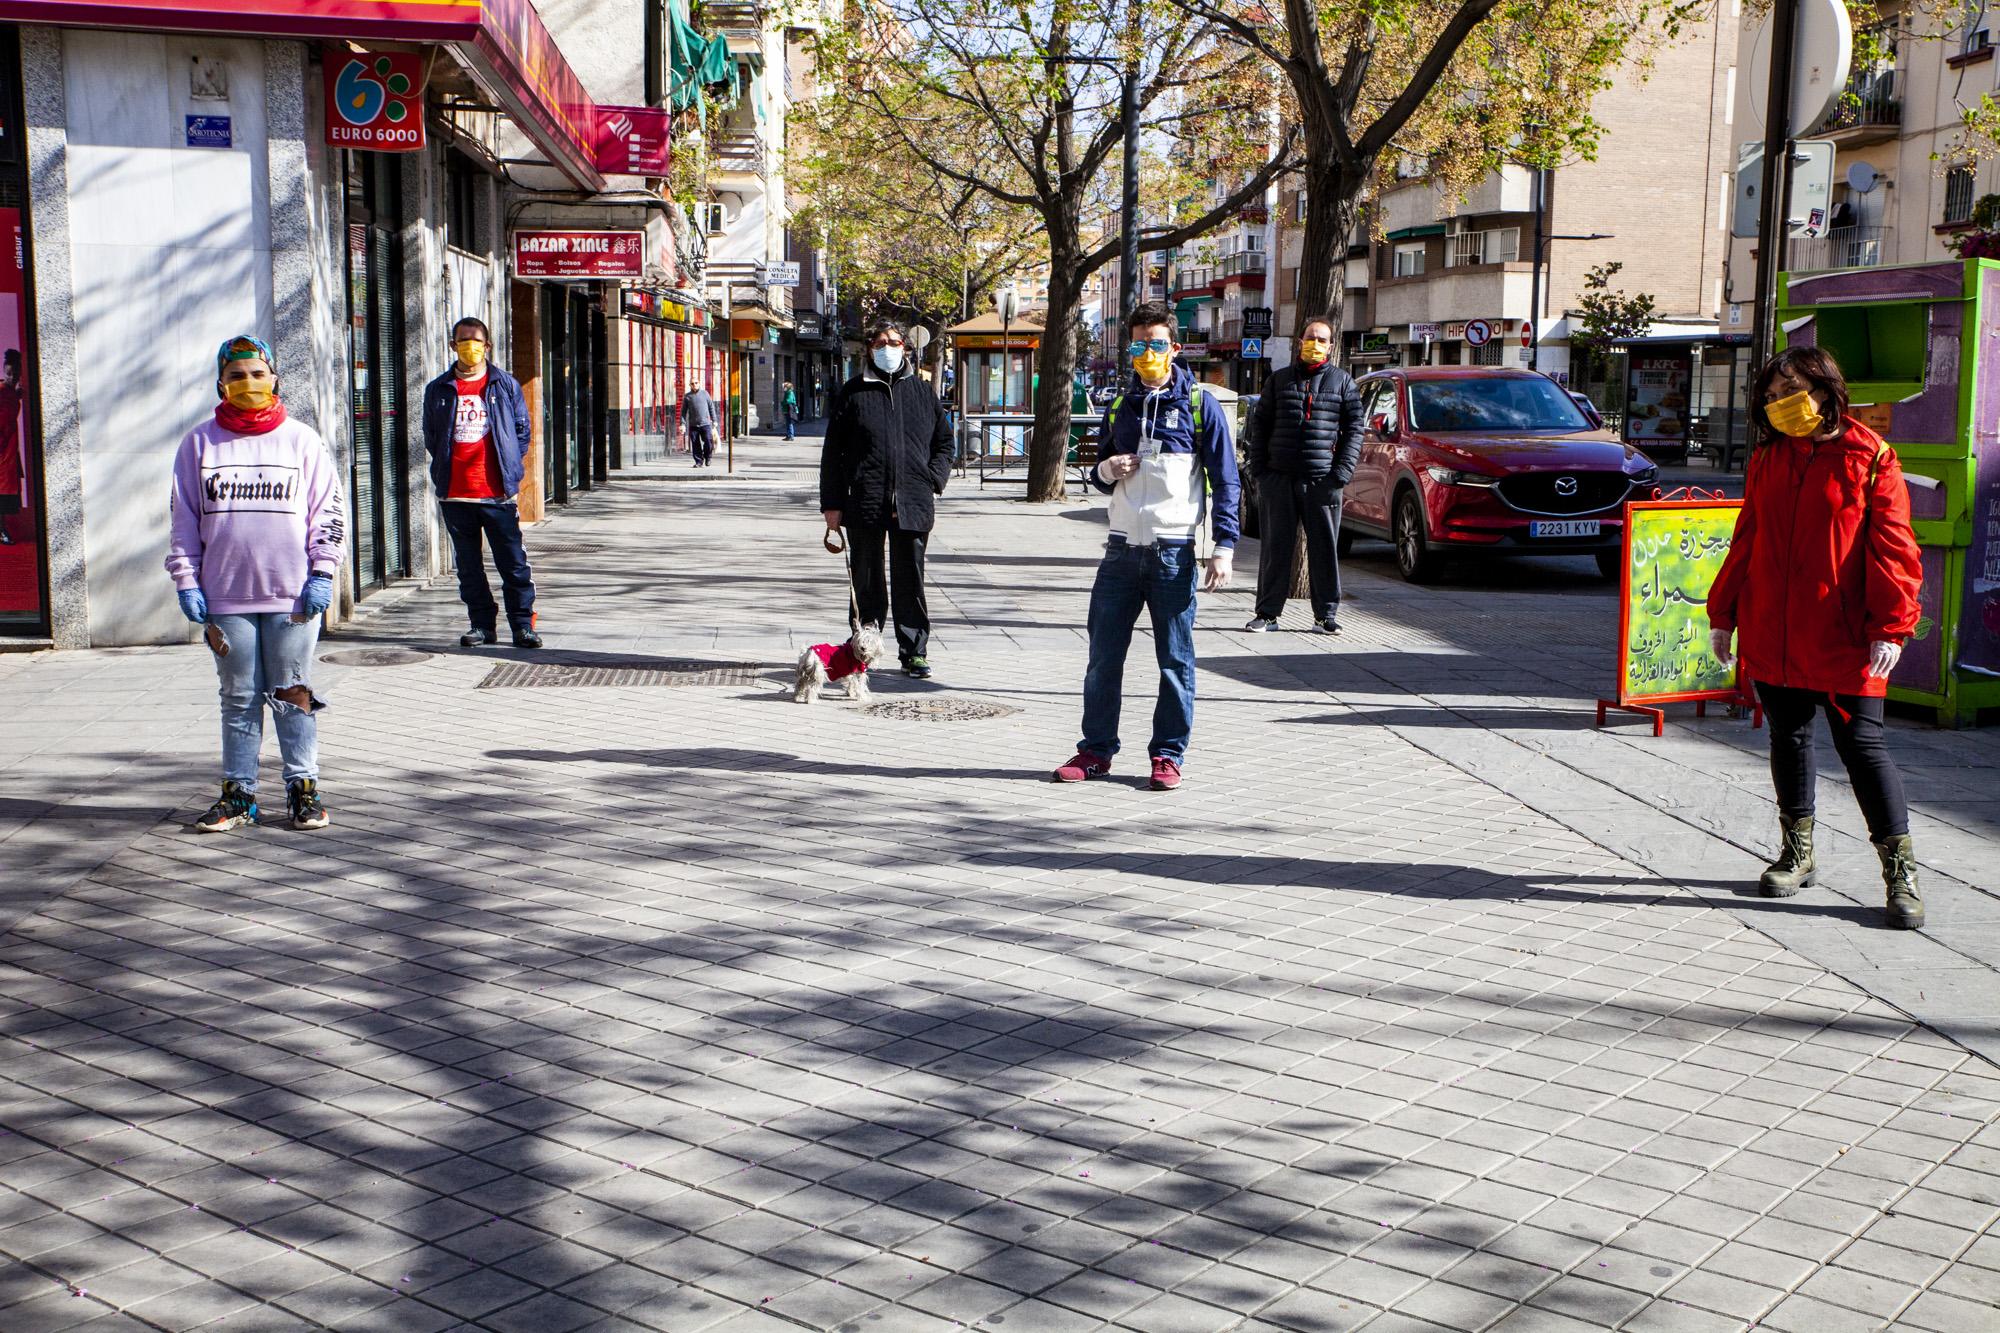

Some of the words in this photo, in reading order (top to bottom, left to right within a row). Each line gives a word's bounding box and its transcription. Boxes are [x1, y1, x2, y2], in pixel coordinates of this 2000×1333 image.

[332, 127, 372, 140] EURO
[376, 129, 417, 142] 6000
[520, 237, 568, 253] BAZAR
[571, 238, 609, 253] XINLE
[613, 236, 640, 254] 鑫乐
[526, 260, 544, 268] Ropa
[598, 260, 626, 269] Regalos
[526, 268, 547, 276] Gafas
[1248, 312, 1267, 324] ZAIDA
[1652, 360, 1680, 369] KFC
[205, 472, 293, 502] Criminal
[1539, 523, 1570, 535] 2231
[1574, 522, 1597, 534] KYV
